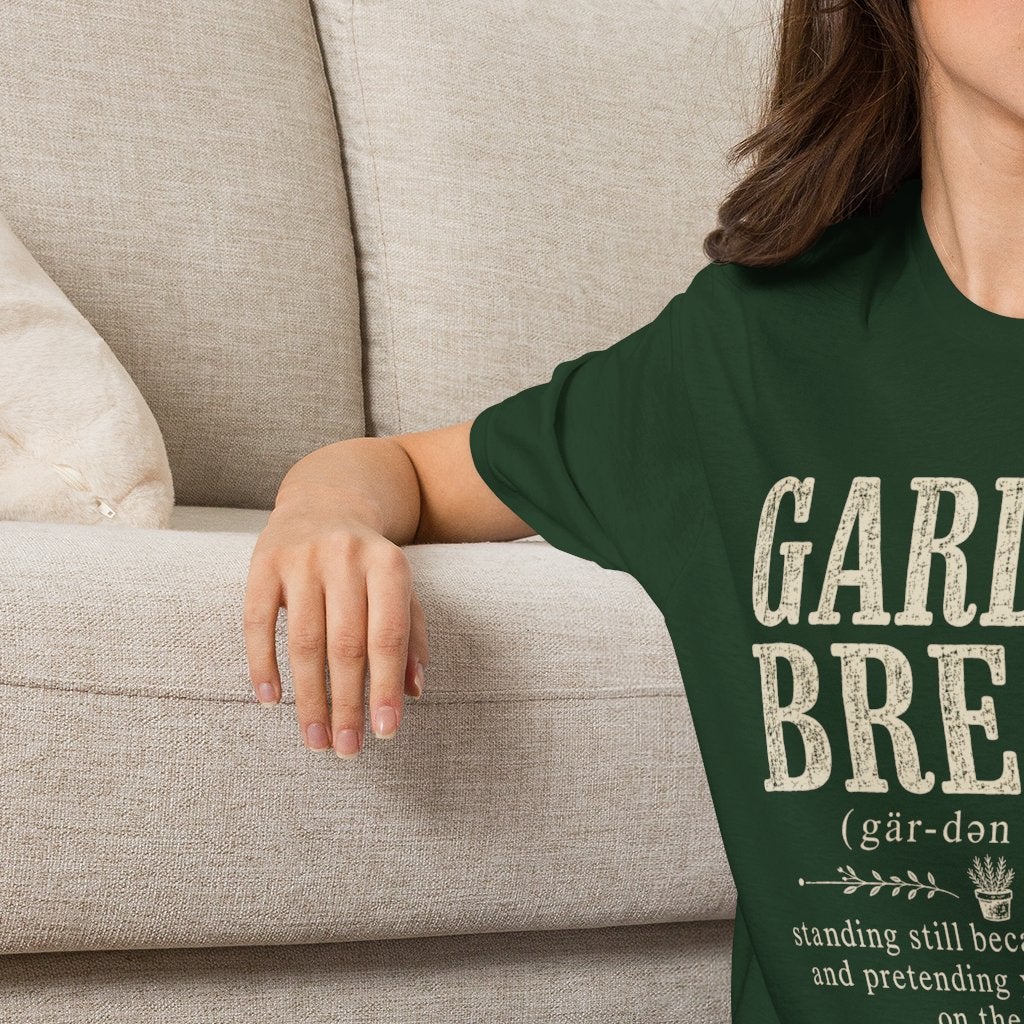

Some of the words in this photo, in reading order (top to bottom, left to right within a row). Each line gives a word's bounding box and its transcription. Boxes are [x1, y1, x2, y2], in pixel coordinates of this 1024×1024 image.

[792, 919, 901, 957] standing
[908, 921, 964, 952] still
[811, 958, 855, 987] and
[862, 963, 1011, 1001] pretending
